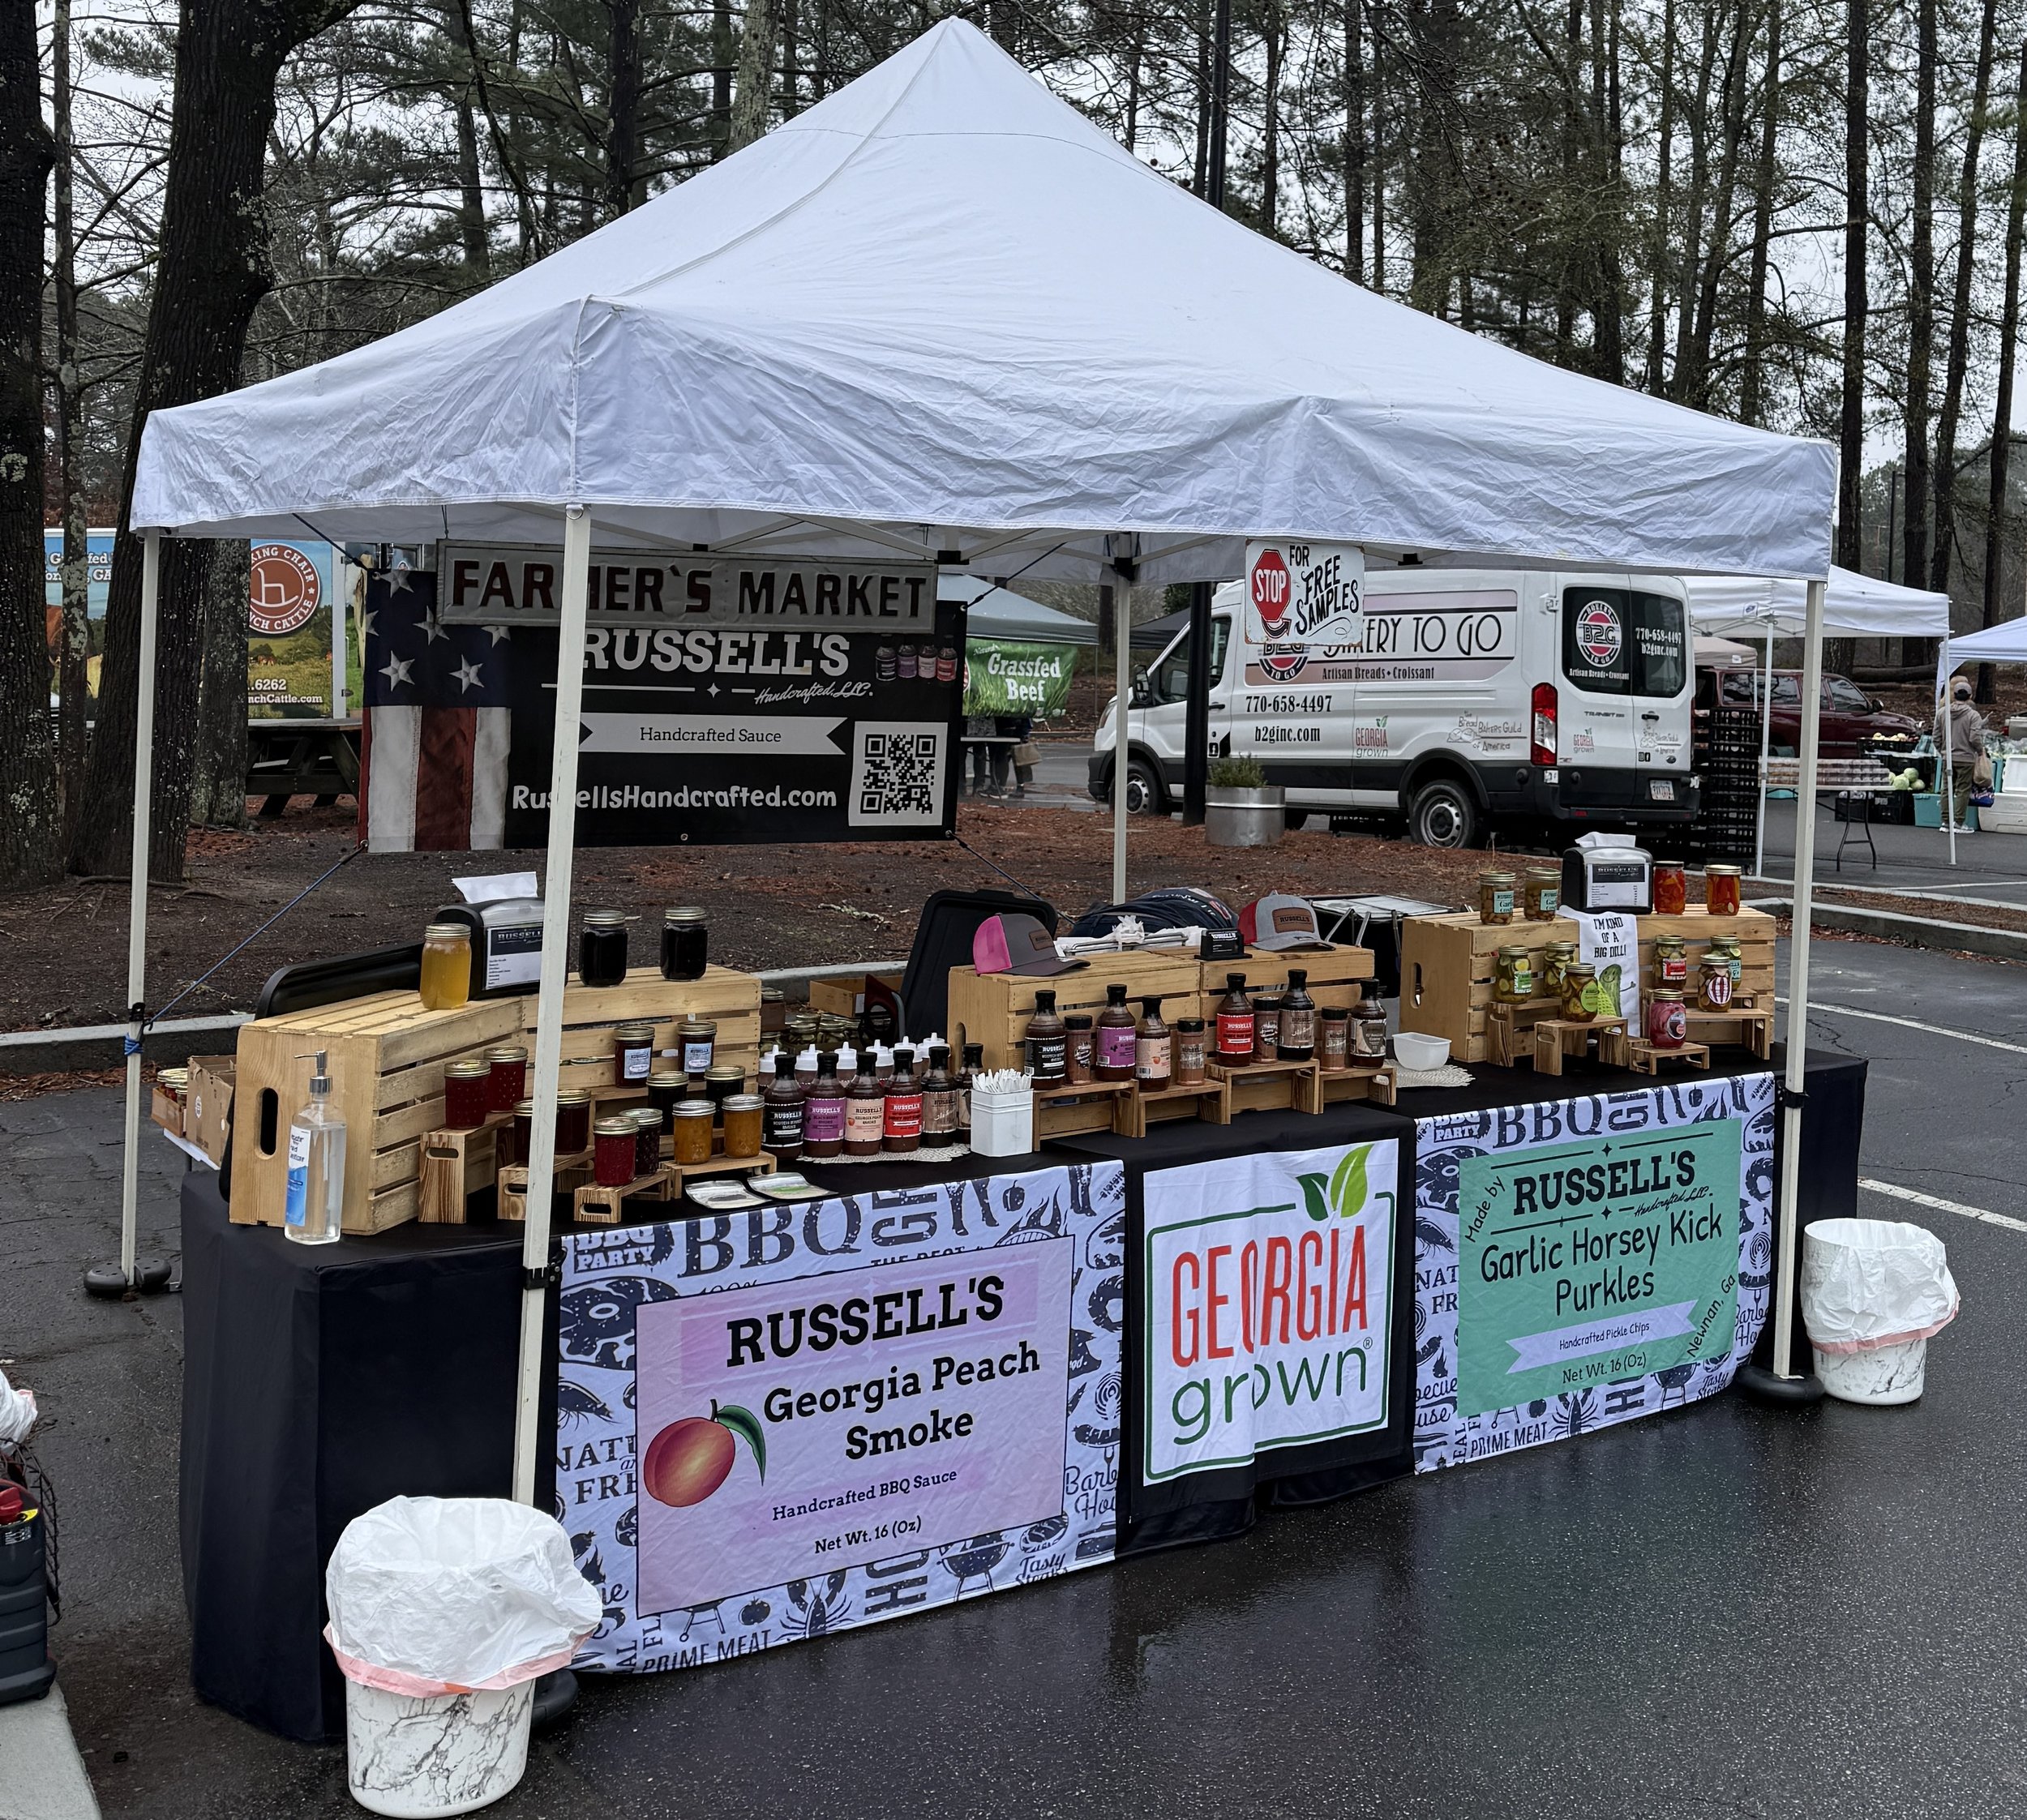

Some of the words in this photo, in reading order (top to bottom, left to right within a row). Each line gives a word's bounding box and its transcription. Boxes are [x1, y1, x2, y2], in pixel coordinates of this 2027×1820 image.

[284, 550, 315, 582] CHAIR
[1289, 545, 1309, 567] FOR
[739, 570, 926, 618] MARKET
[1255, 569, 1286, 603] STOP
[1301, 555, 1340, 605] FREE
[274, 600, 313, 630] CATTLE
[1294, 579, 1359, 635] SAMPLES
[1413, 616, 1446, 653] TO
[1457, 614, 1502, 656] GO
[1583, 623, 1616, 645] B2G
[583, 628, 850, 676] RUSSELL'S
[988, 653, 1061, 678] Grassfed
[1271, 669, 1280, 679] TO
[1284, 668, 1296, 679] GO
[1322, 667, 1352, 679] Artisan
[1355, 666, 1385, 679] Breads
[1393, 666, 1434, 679] Croissant
[1005, 679, 1045, 701] Beef
[1245, 696, 1332, 713] 770-658-4497
[641, 727, 735, 742] Handcrafted
[739, 729, 782, 743] Sauce
[1255, 726, 1321, 743] b2ginc.com
[1356, 727, 1388, 747] GEORGIA
[1459, 716, 1478, 727] Bread
[1356, 747, 1388, 758] grown
[1482, 741, 1511, 752] America
[512, 785, 837, 809] RuellsHandcrafted.com
[1593, 918, 1605, 930] I'M
[1606, 917, 1624, 930] KIND
[1601, 932, 1610, 943] OF
[1613, 931, 1619, 943] A
[1594, 947, 1608, 958] BIG
[1435, 1124, 1481, 1141] PARTY
[1493, 1094, 1603, 1149] BBQ
[1513, 1150, 1695, 1215] RUSSELL'S
[1465, 1201, 1491, 1243] Made
[1485, 1176, 1506, 1197] by
[677, 1196, 862, 1278] BBQ
[1481, 1235, 1563, 1283] Garlic
[1573, 1224, 1661, 1266] Horsey
[1669, 1202, 1723, 1247] Kick
[577, 1246, 656, 1270] PARTY
[1172, 1225, 1368, 1368] GEORGIA
[1556, 1265, 1655, 1317] Purkles
[726, 1275, 1004, 1368] RUSSELL'S
[1686, 1298, 1725, 1358] Newnan,
[1721, 1274, 1736, 1294] Ga
[1559, 1331, 1605, 1350] Handcrafted
[1606, 1325, 1628, 1339] Pickle
[1630, 1321, 1650, 1337] Chips
[764, 1365, 921, 1423] Georgia
[932, 1340, 1040, 1392] Peach
[1562, 1369, 1583, 1384] Net
[1586, 1363, 1607, 1378] Wt.
[1610, 1359, 1621, 1372] 16
[1624, 1351, 1647, 1372] (Oz)
[1172, 1347, 1366, 1445] grown
[846, 1409, 974, 1459] Smoke
[1470, 1431, 1511, 1458] PRIME
[1515, 1421, 1548, 1451] MEAT
[772, 1485, 876, 1521] Handcrafted
[879, 1478, 911, 1497] BBQ
[913, 1471, 958, 1489] Sauce
[814, 1537, 842, 1554] Net
[845, 1531, 872, 1547] Wt.
[875, 1524, 889, 1540] 16
[892, 1515, 922, 1538] (Oz)
[717, 1629, 772, 1659] MEAT
